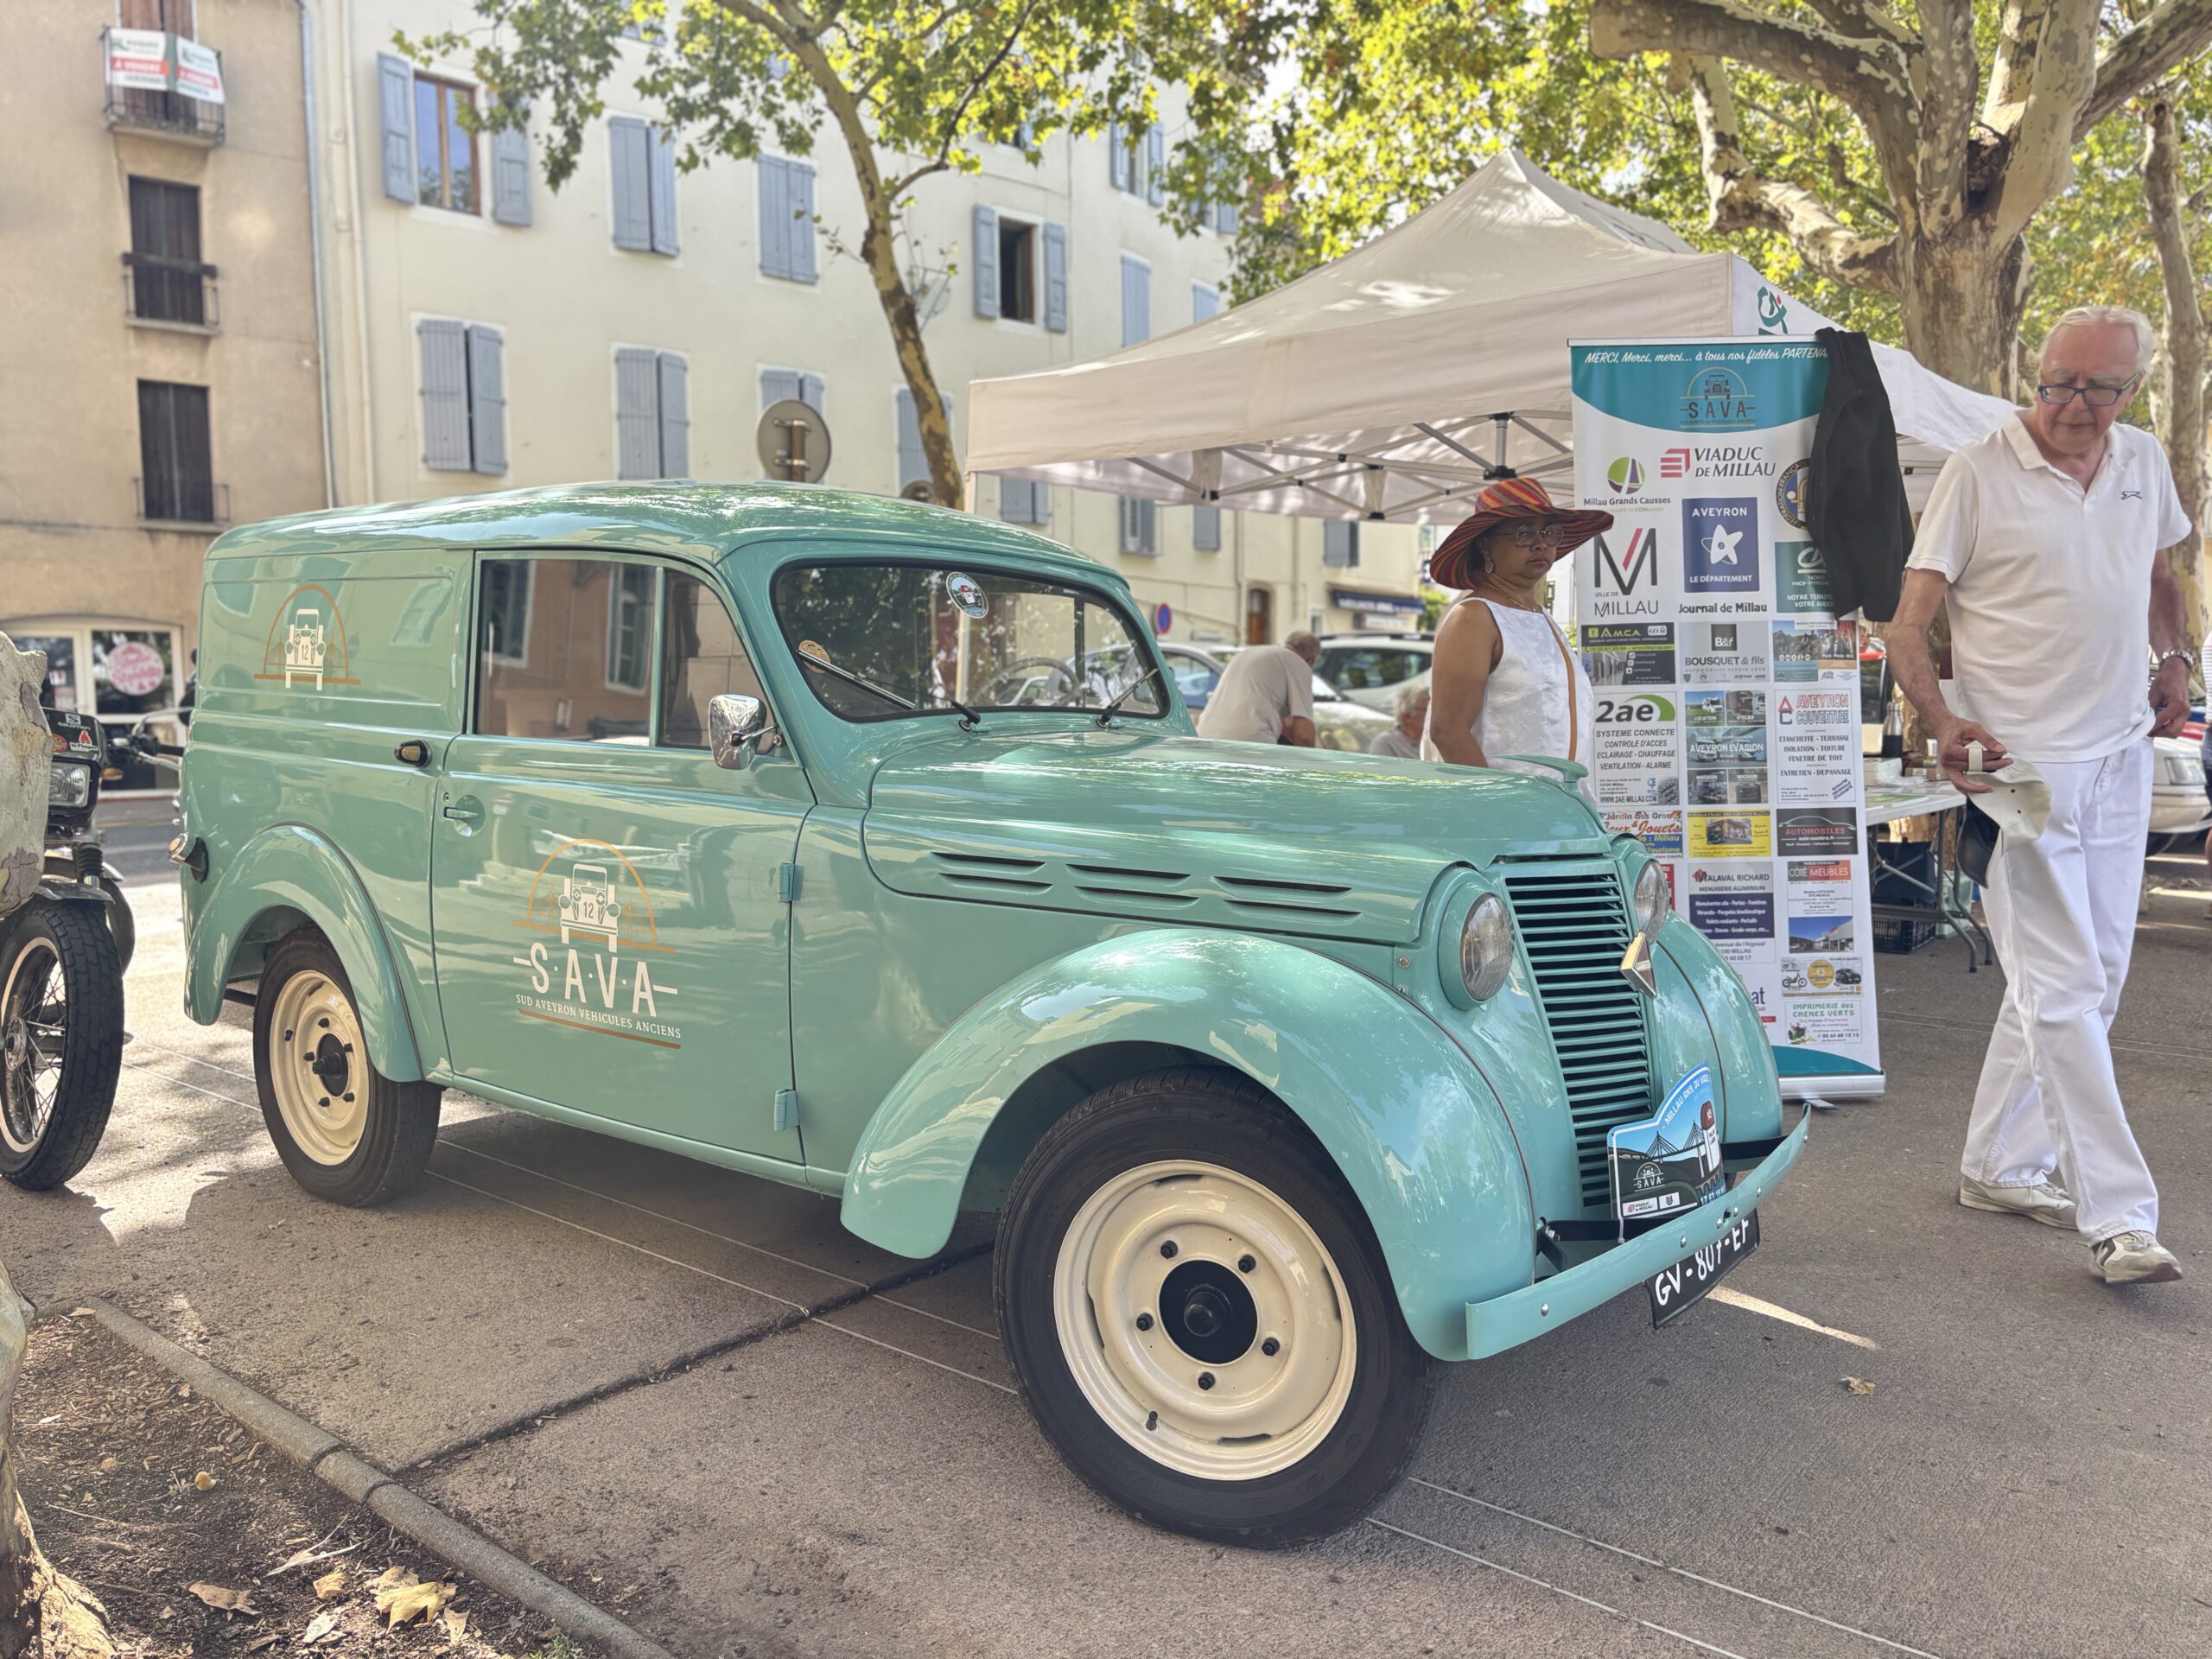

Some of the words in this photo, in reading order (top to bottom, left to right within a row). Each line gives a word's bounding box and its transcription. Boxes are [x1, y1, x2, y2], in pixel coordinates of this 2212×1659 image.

[1621, 351, 1651, 363] Merci,
[1695, 351, 1702, 361] à
[1705, 351, 1726, 360] tous
[1727, 352, 1745, 360] nos
[1745, 348, 1780, 364] fidèles
[1781, 347, 1828, 359] PARTENA
[1694, 447, 1763, 461] VIADUC
[1695, 467, 1711, 477] DE
[1713, 462, 1777, 477] MILLAU
[1692, 507, 1748, 517] AVEYRON
[1594, 601, 1659, 618] MILLAU
[1678, 603, 1718, 613] Journal
[1720, 603, 1732, 613] de
[1735, 602, 1768, 613] Millau
[1715, 636, 1734, 647] B&f
[1685, 656, 1740, 665] BOUSQUET
[1740, 657, 1749, 665] &
[1751, 655, 1765, 664] fils
[1796, 694, 1849, 708] AVEYRON
[1595, 700, 1654, 723] 2ae
[1796, 710, 1850, 725] COUVERTURE
[1689, 744, 1727, 753] AVEYRON
[1729, 743, 1764, 752] EVASION
[1694, 871, 1735, 883] MALAVAL
[1809, 868, 1849, 877] MEUBLES
[582, 900, 594, 919] 12
[516, 994, 533, 1007] SUD
[535, 999, 576, 1017] AVEYRON
[578, 1007, 632, 1029] VEHICULES
[635, 1020, 682, 1039] ANCIENS
[1664, 1096, 1686, 1125] MILLAU
